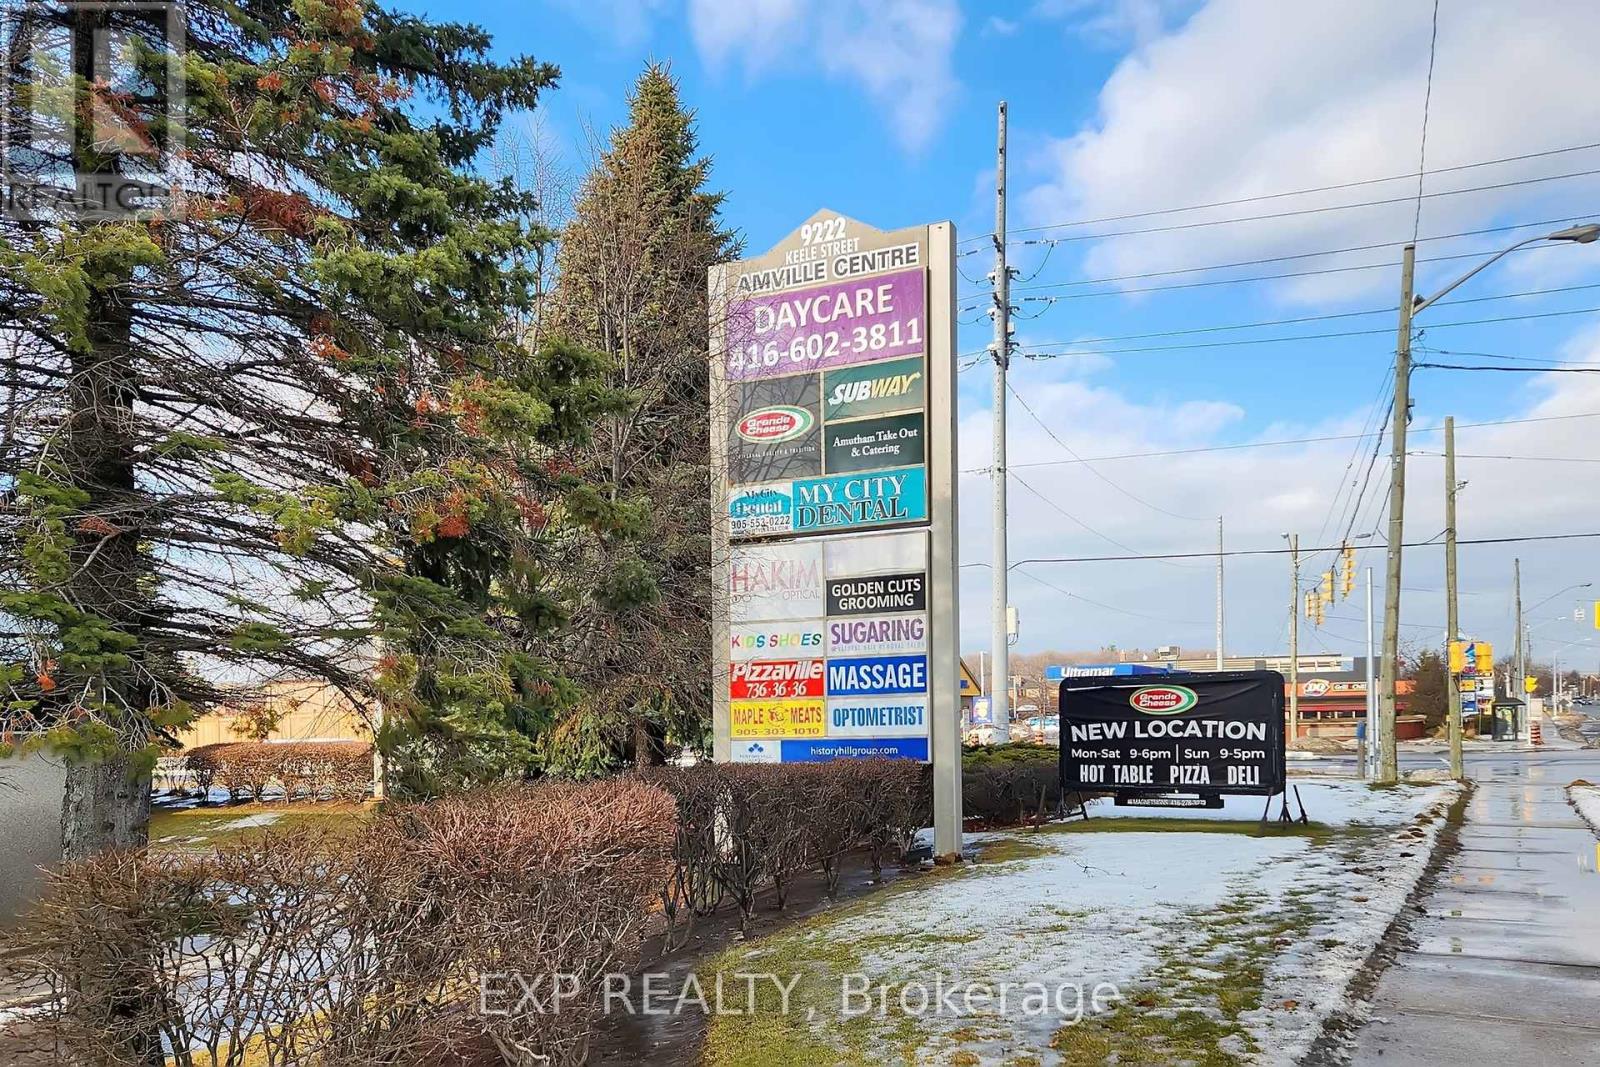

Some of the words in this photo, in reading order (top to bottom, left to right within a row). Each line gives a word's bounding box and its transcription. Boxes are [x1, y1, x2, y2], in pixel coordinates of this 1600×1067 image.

[801, 217, 846, 247] 9222
[786, 245, 817, 265] KEELE
[821, 237, 860, 258] STREET
[737, 260, 826, 294] AMVILLE
[833, 242, 918, 278] CENTRE
[754, 284, 894, 334] DAYCARE
[729, 317, 922, 371] 416-602-3811
[828, 371, 922, 406] SUBWAY
[746, 415, 791, 427] Grande
[833, 435, 875, 447] Amutham
[876, 431, 897, 442] Take
[899, 428, 918, 439] Out
[851, 447, 861, 457] &
[862, 444, 900, 456] Catering
[800, 480, 840, 504] MY
[845, 474, 908, 500] CITY
[798, 497, 908, 528] DENTAL
[732, 560, 820, 593] HAKIM
[832, 581, 884, 597] GOLDEN
[887, 578, 921, 592] CUTS
[839, 594, 914, 610] GROOMING
[732, 634, 765, 648] KIDS
[769, 633, 821, 648] SHOES
[831, 618, 924, 645] SUGARING
[732, 661, 823, 682] Pizzaville
[830, 663, 925, 690] MASSAGE
[1061, 667, 1115, 678] Ultramar
[1139, 699, 1177, 707] Cheese
[1140, 693, 1177, 701] Grande
[734, 708, 764, 724] MAPLE
[791, 707, 821, 724] MEATS
[832, 705, 924, 727] OPTOMETRIST
[736, 728, 819, 736] 905-303-1010
[1071, 721, 1127, 742] NEW
[1134, 720, 1266, 741] LOCATION
[811, 745, 898, 757] historyhillgroup.com
[1071, 749, 1120, 759] Mon-Sat
[1130, 749, 1171, 762] 9-6pm
[1184, 749, 1210, 759] Sun
[1220, 749, 1265, 762] 9-5pm
[1080, 765, 1105, 783] HOT
[1113, 765, 1153, 784] TABLE
[1170, 765, 1210, 784] PIZZA
[1227, 765, 1259, 785] DELI
